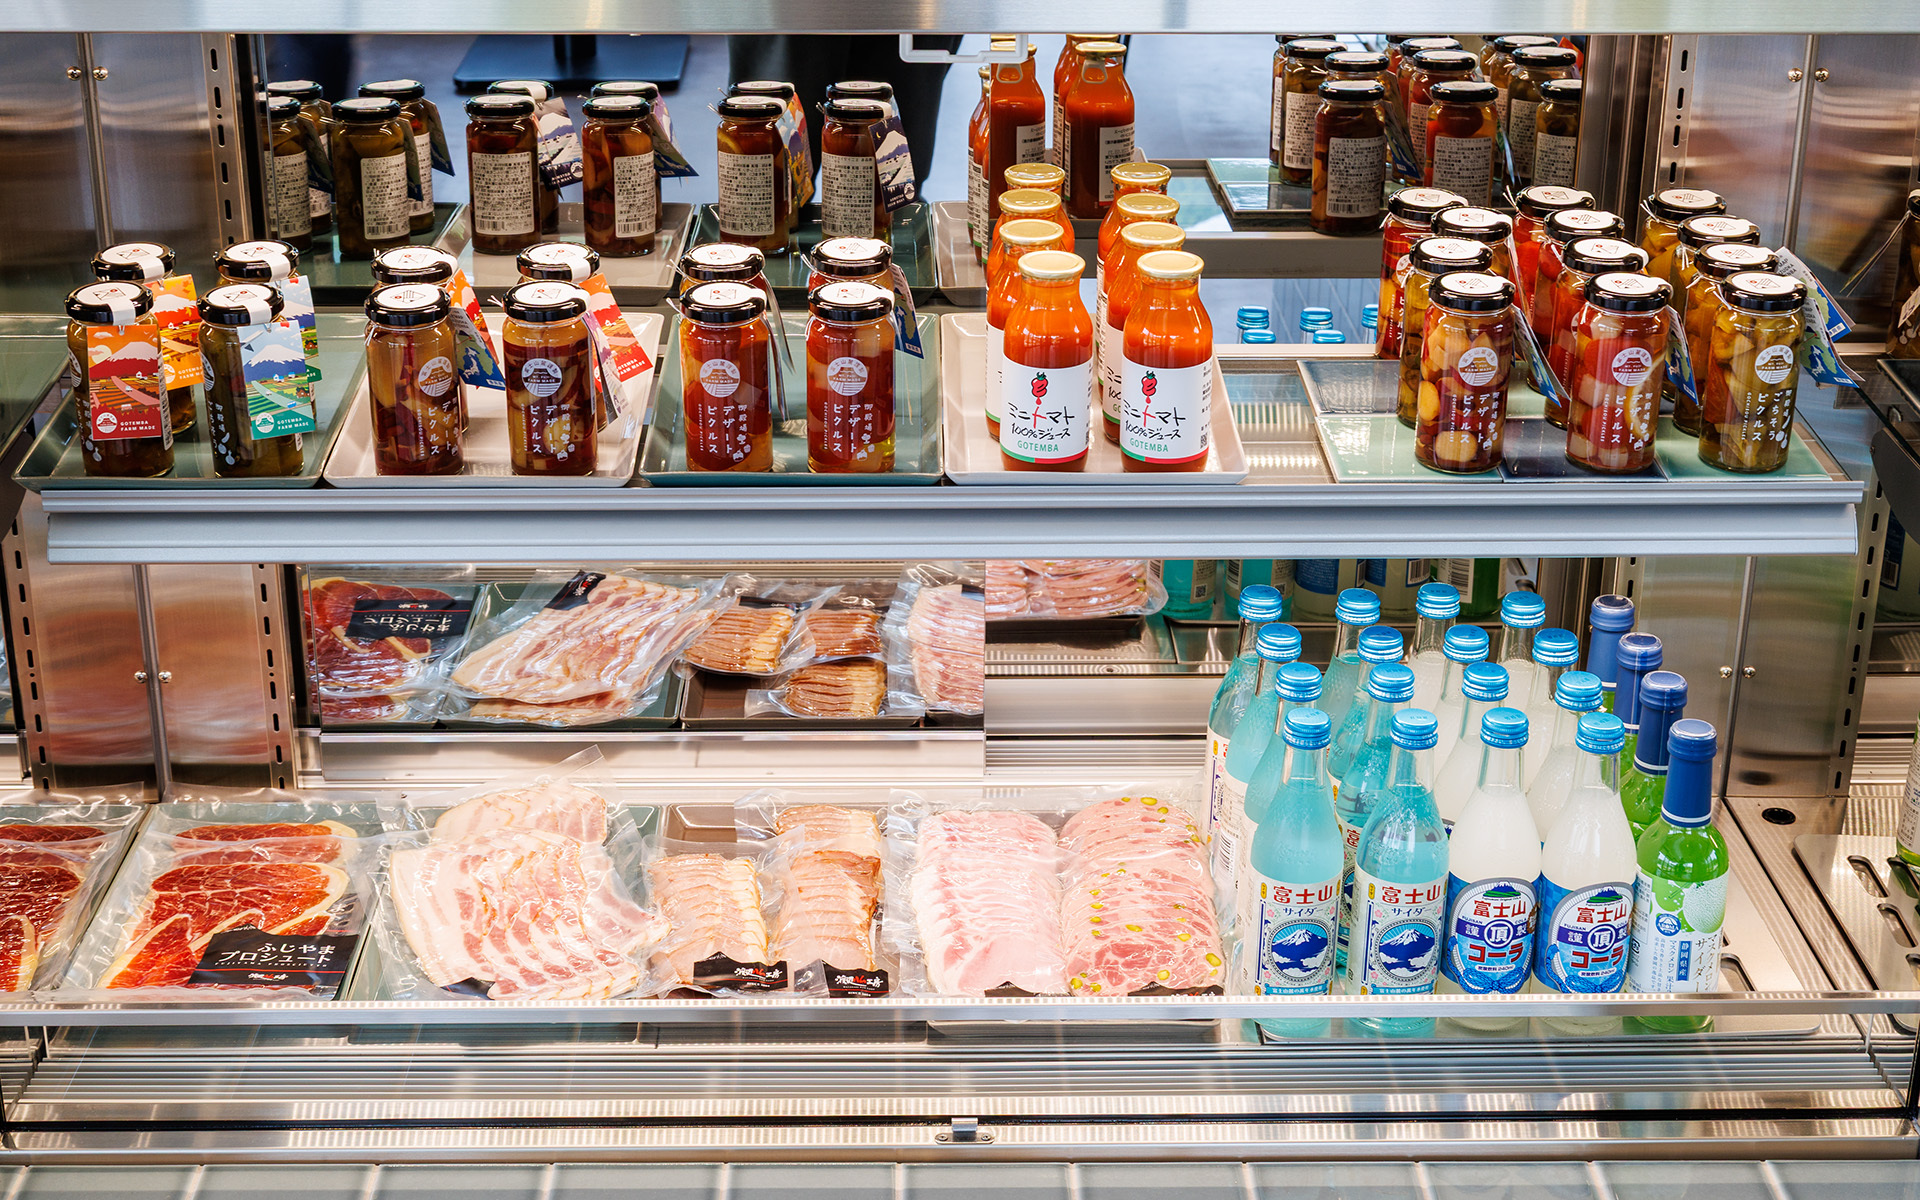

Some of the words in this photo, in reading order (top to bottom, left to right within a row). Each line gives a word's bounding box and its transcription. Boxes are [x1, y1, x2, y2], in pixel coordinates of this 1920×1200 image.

[442, 400, 451, 451] デザート
[1008, 402, 1075, 429] ミニトマト
[1123, 399, 1186, 427] ミニトマト
[1460, 395, 1474, 443] ピクルス
[1478, 394, 1490, 443] デザート
[1611, 395, 1626, 443] ピクルス
[1629, 394, 1643, 443] デザート
[1752, 393, 1769, 440] ピクルス
[1769, 392, 1783, 440] ごちそう
[428, 407, 440, 455] ピクルス
[530, 405, 542, 454] ピクルス
[546, 405, 557, 454] デザート
[708, 406, 718, 453] ピクルス
[723, 406, 735, 454] デザート
[833, 404, 843, 452] ピクルス
[848, 404, 861, 453] デザート
[1011, 422, 1070, 440] 100%ジュース
[1125, 420, 1181, 440] 100%ジュース
[1017, 440, 1059, 452] GOTEMBA
[1130, 438, 1169, 452] GOTEMBA
[1273, 885, 1332, 904] 富士山
[1382, 885, 1440, 904] 富士山
[1283, 907, 1324, 917] サイダー
[1391, 907, 1431, 917] サイダー
[1462, 916, 1483, 924] FUJISAN
[1473, 900, 1526, 918] 富士山
[1577, 904, 1627, 923] 富士山
[1490, 926, 1508, 942] 頂
[1593, 931, 1611, 947] 頂
[219, 950, 330, 963] プロシュート
[257, 943, 335, 954] ふじやま
[1468, 942, 1523, 962] コーラ
[1571, 945, 1624, 968] コーラ
[1680, 942, 1689, 976] 静岡県産
[1704, 934, 1717, 990] マスクメロン
[1693, 938, 1707, 992] サイダー
